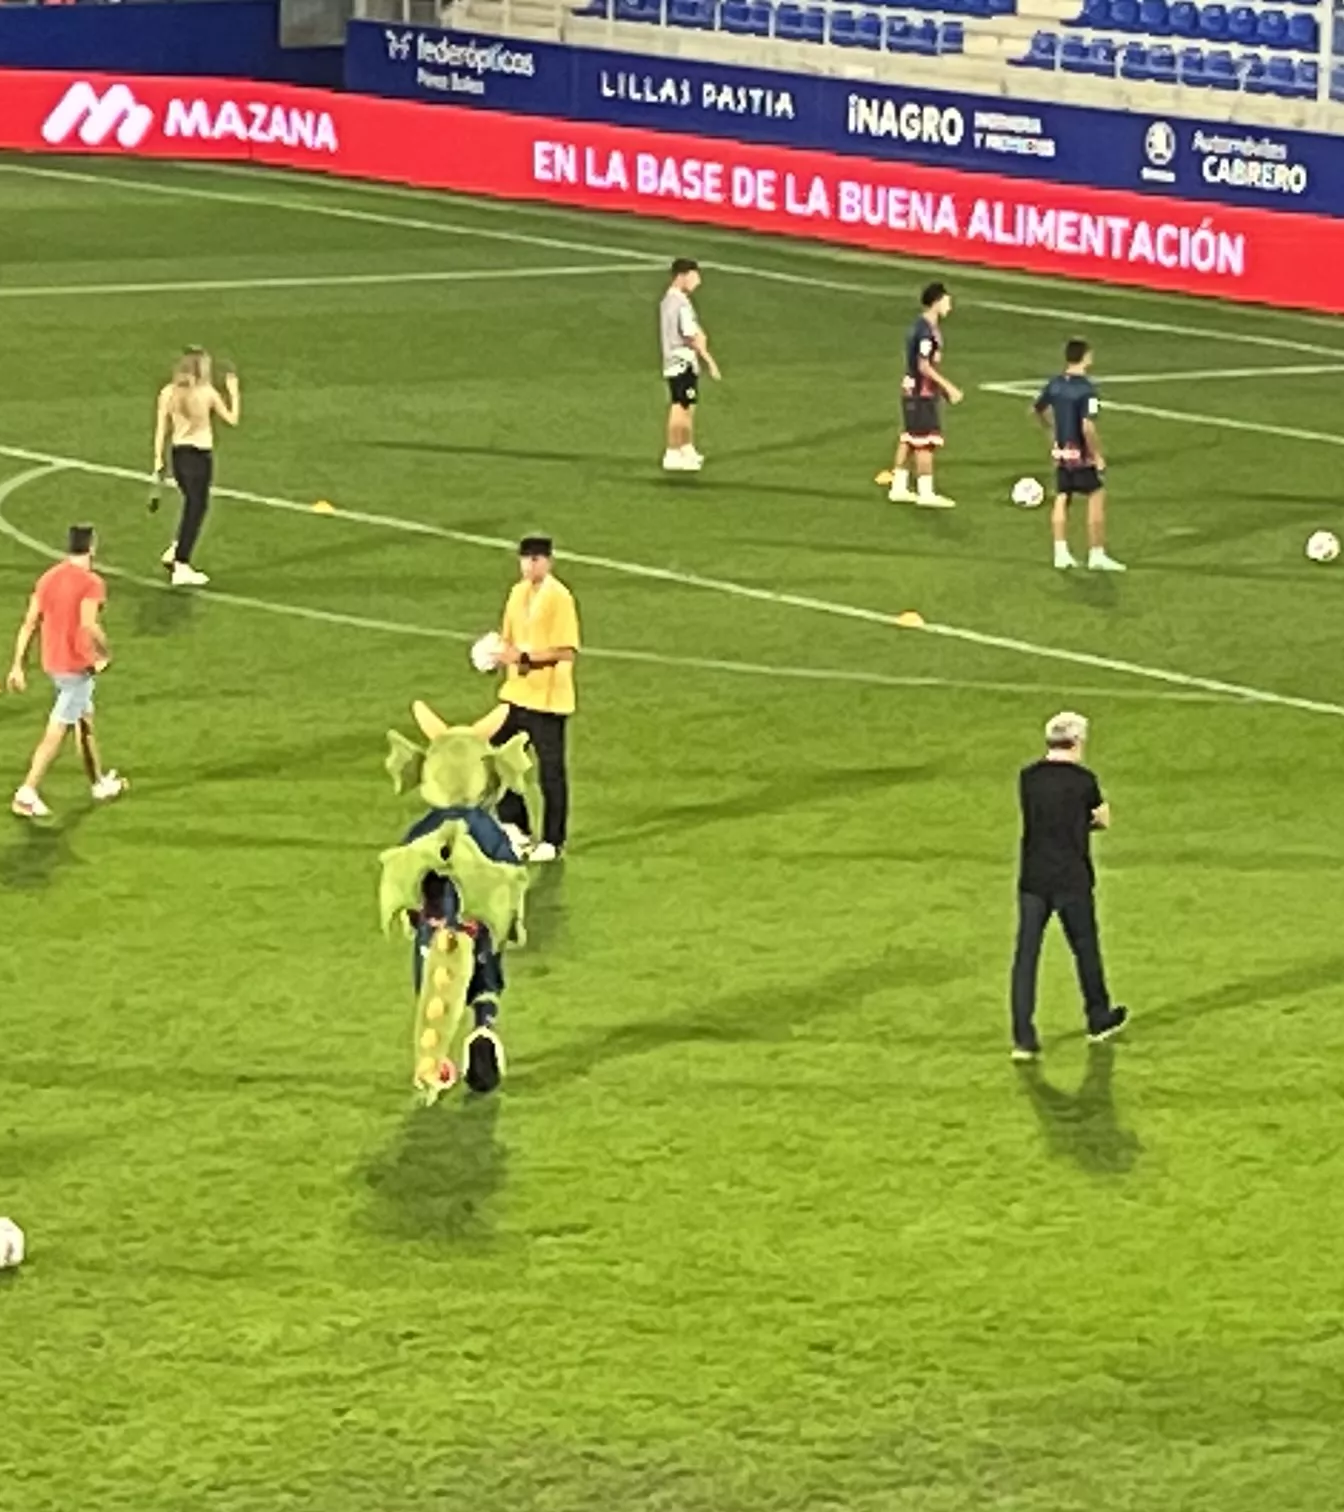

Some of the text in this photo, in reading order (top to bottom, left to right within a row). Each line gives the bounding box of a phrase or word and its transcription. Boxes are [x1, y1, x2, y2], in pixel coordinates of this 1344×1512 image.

[600, 71, 796, 120] LILLAS PASTIA
[163, 97, 338, 154] MAZANA
[1201, 155, 1307, 194] CABRERO
[532, 140, 1246, 277] EN LA BASE DE LA BUENA ALIMENTACIÓN
